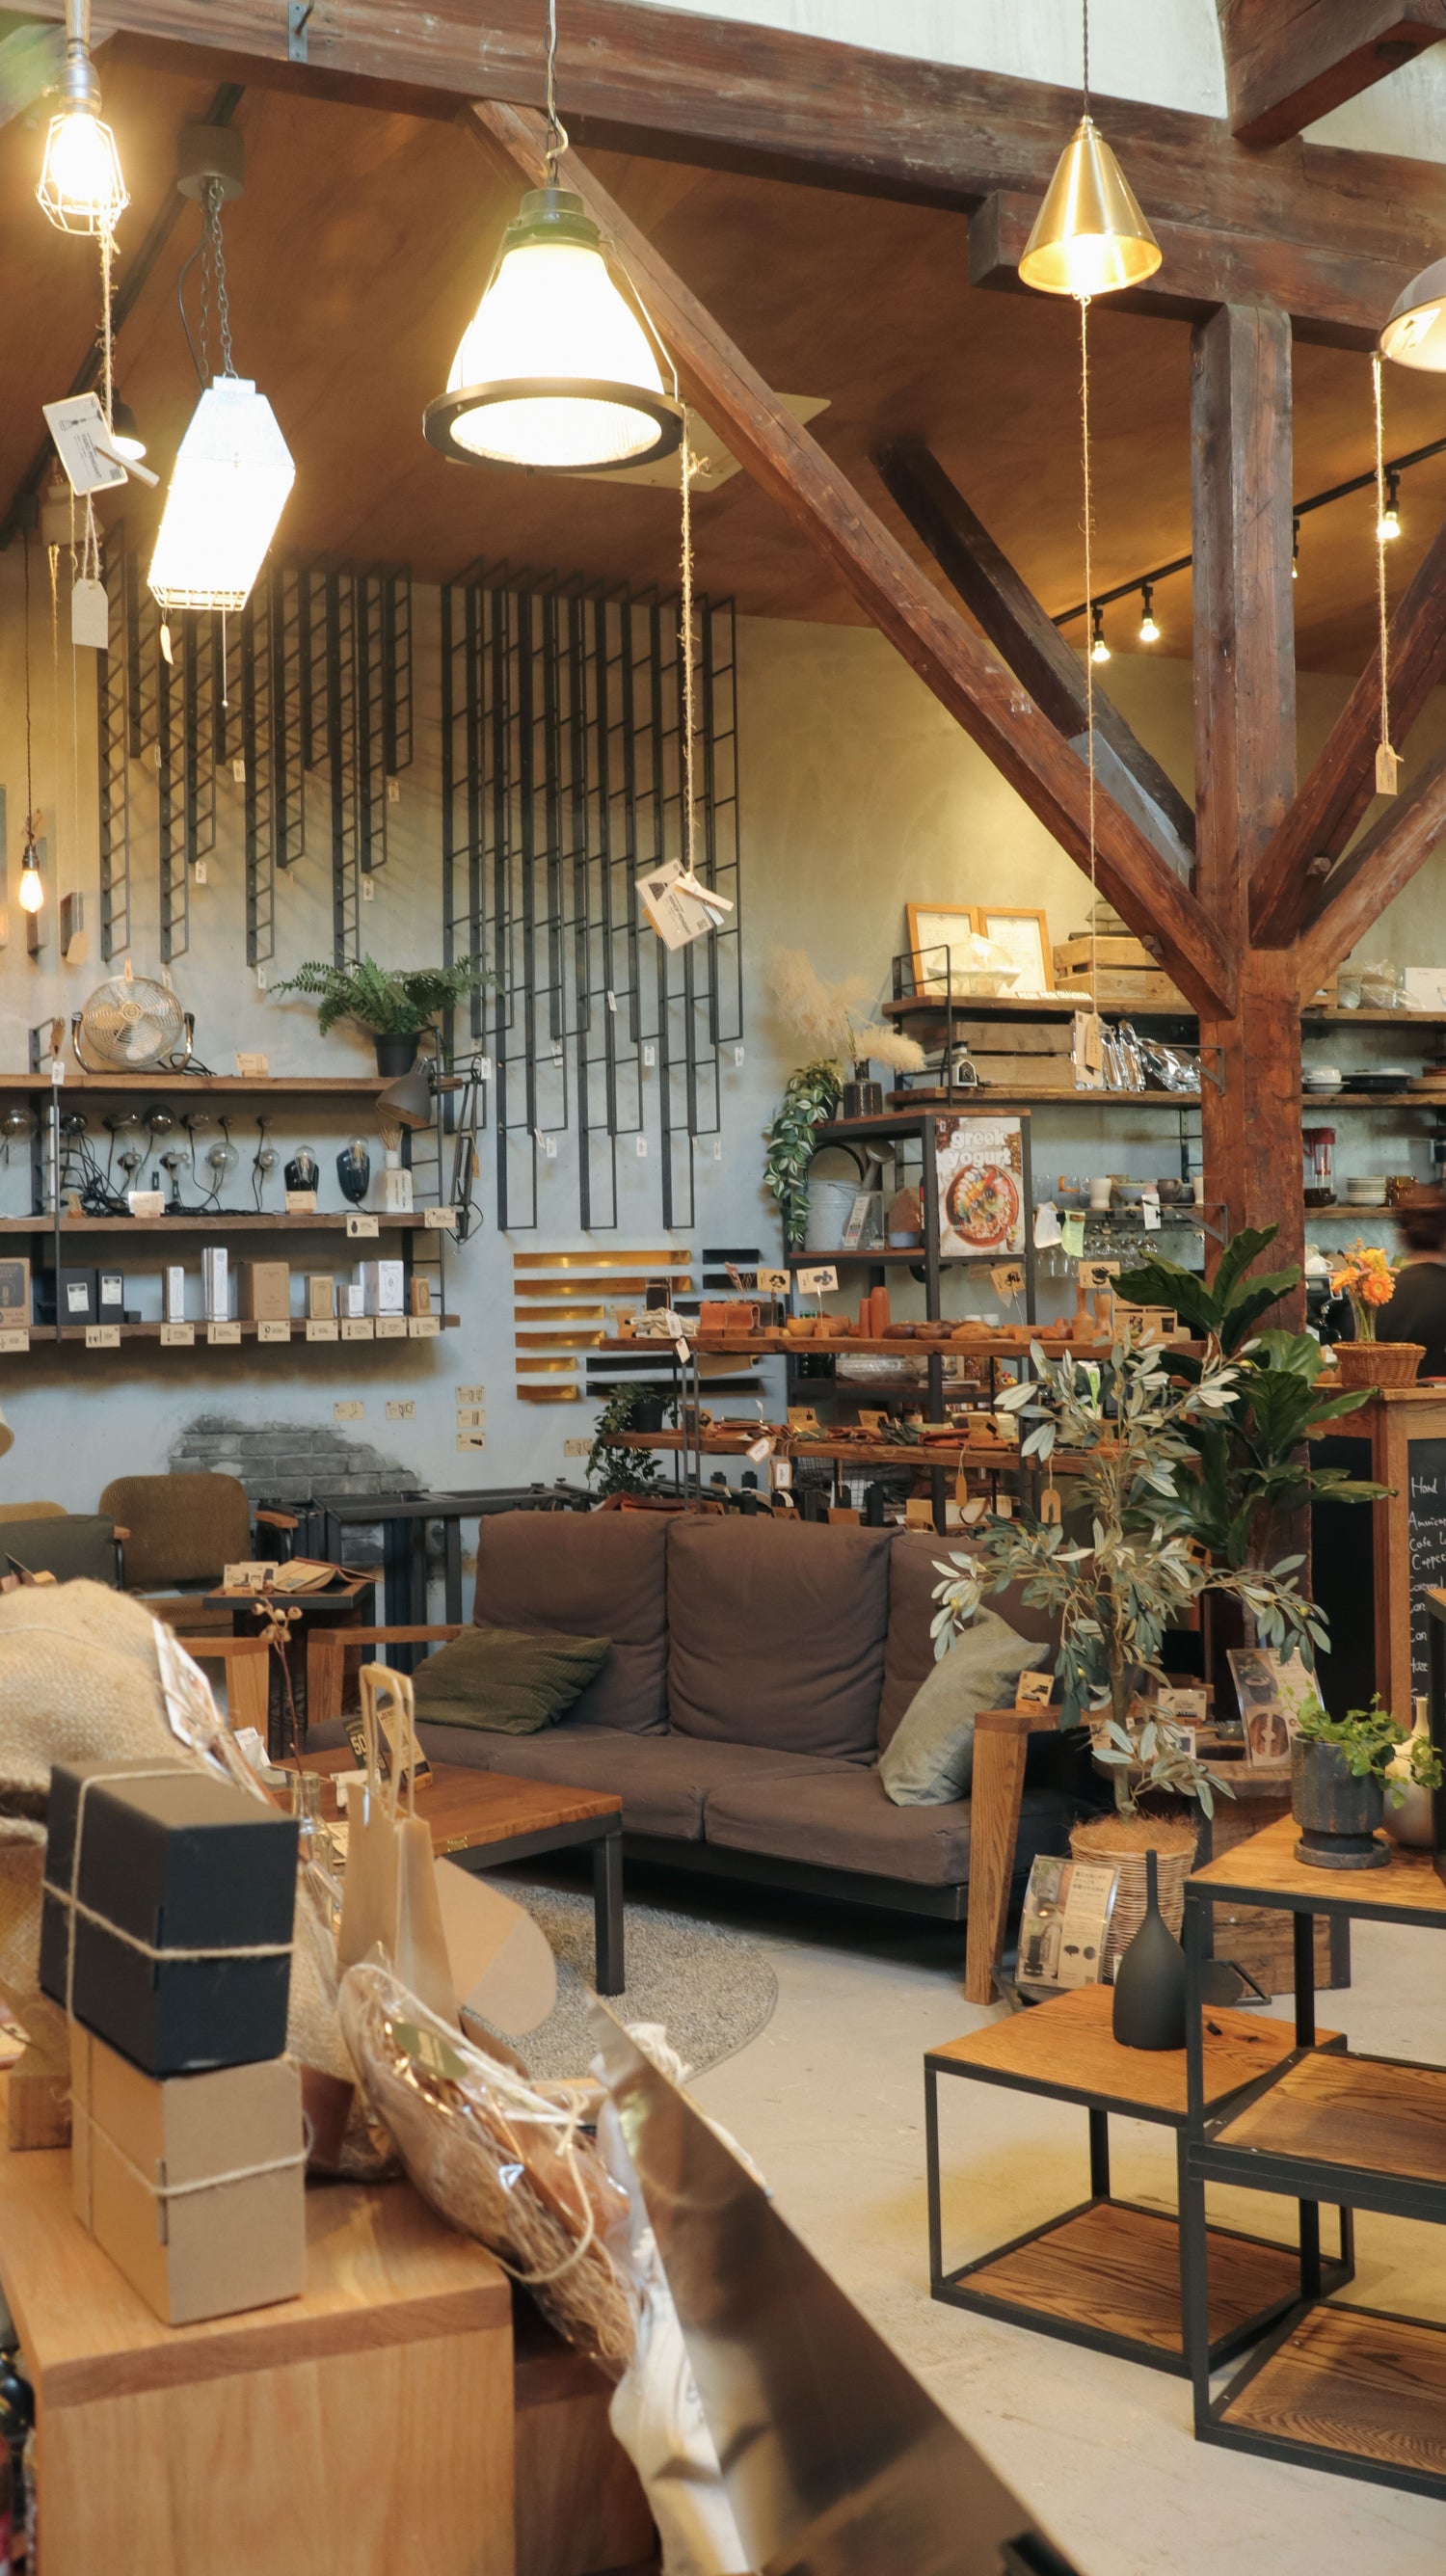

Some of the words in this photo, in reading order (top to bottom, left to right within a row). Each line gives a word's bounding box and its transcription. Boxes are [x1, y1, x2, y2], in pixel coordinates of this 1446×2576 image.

[951, 1128, 1005, 1150] greek
[948, 1146, 1012, 1168] yogurt
[1409, 1536, 1433, 1551] Cafe
